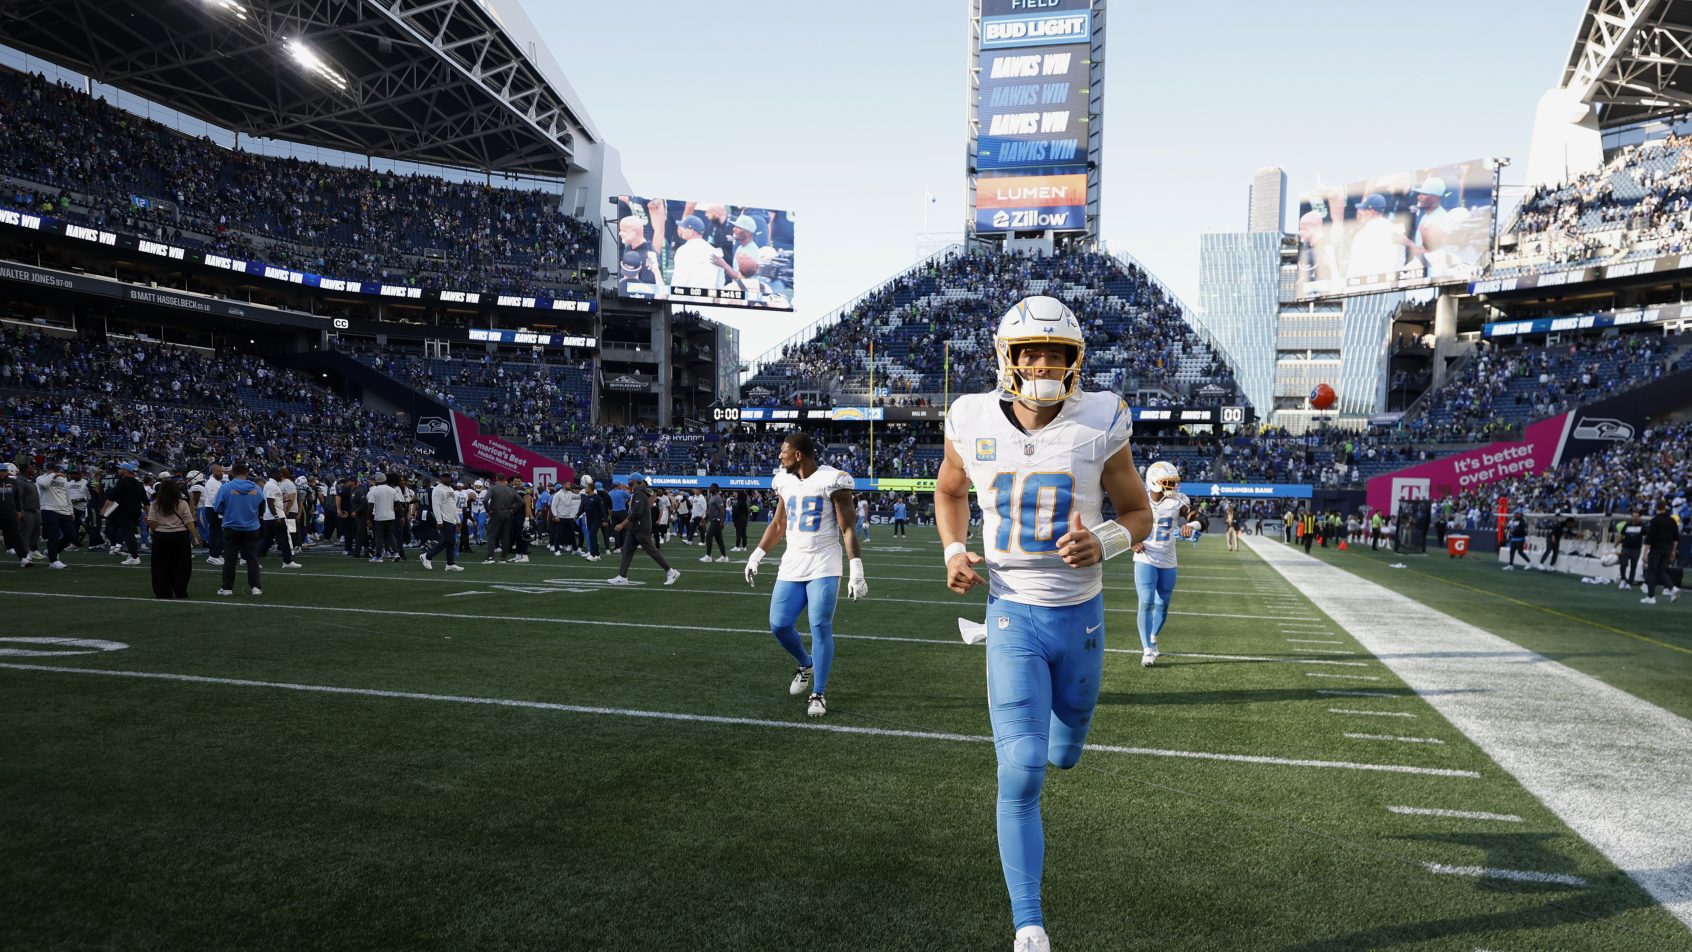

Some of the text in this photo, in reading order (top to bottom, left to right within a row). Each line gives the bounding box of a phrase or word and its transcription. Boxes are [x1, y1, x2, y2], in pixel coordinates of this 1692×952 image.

[986, 17, 1084, 40] BUD LIGHT
[990, 52, 1072, 79] HAWKS WIN
[989, 82, 1070, 108] HAWKS WIN
[989, 110, 1070, 136] HAWKS WIN
[998, 138, 1079, 163] HAWKS WIN
[997, 186, 1065, 201] LUMEN
[0, 209, 41, 230] WKS WIN
[1010, 210, 1068, 228] Zillow
[65, 223, 117, 246] HAWKS WIN
[138, 240, 185, 260] HAWKS WIN
[204, 254, 247, 273] HAWKS WIN
[1606, 259, 1656, 279] HAWKS WIN
[0, 267, 30, 281] WALTER
[31, 273, 56, 286] JONES
[264, 266, 303, 284] HAWKS WIN
[1537, 269, 1586, 288] HAWKS WIN
[320, 277, 362, 293] HAWKS WIN
[380, 284, 422, 299] HAWKS WIN
[1474, 277, 1518, 294] HAWKS WIN
[130, 290, 137, 299] 8
[137, 291, 156, 302] MATT
[157, 295, 197, 310] HASSELBECK
[439, 290, 480, 304] HAWKS WIN
[497, 295, 536, 309] HAWKS WIN
[552, 299, 590, 312] HAWKS WIN
[335, 320, 347, 328] CC
[1551, 315, 1595, 331] HAWKS WIN
[1614, 309, 1660, 325] HAWKS WIN
[488, 331, 501, 342] WIN
[514, 333, 551, 345] HAWKS WIN
[713, 408, 739, 420] 0:00
[1223, 408, 1241, 421] 00
[472, 440, 527, 467] America's Best
[976, 440, 993, 455] C
[478, 450, 518, 470] Mobile Network
[1454, 443, 1535, 474] It's better
[1459, 457, 1535, 486] over here
[1220, 486, 1254, 494] COLUMBIA
[988, 471, 1076, 555] 10
[1454, 540, 1465, 551] G
